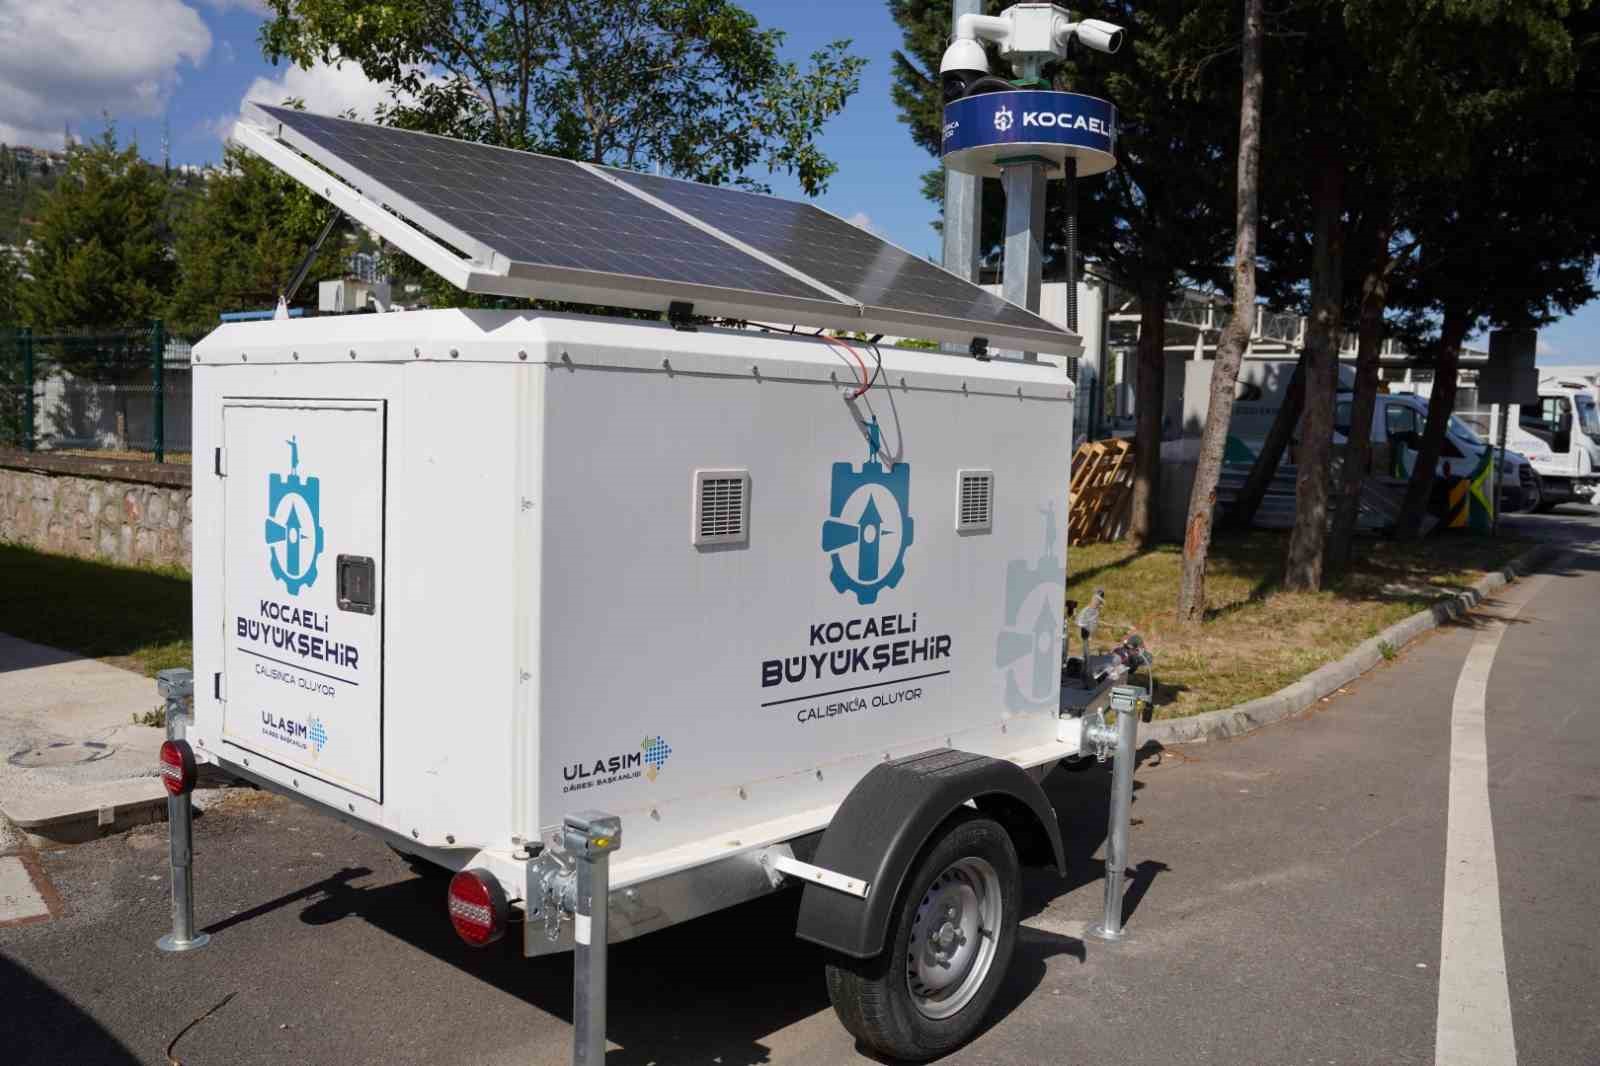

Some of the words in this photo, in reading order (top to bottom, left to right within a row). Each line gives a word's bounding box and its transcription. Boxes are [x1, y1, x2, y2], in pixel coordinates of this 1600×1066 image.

[871, 687, 923, 708] OLUYOR
[262, 710, 307, 740] ULAŞIM
[563, 751, 641, 781] ULAŞIM
